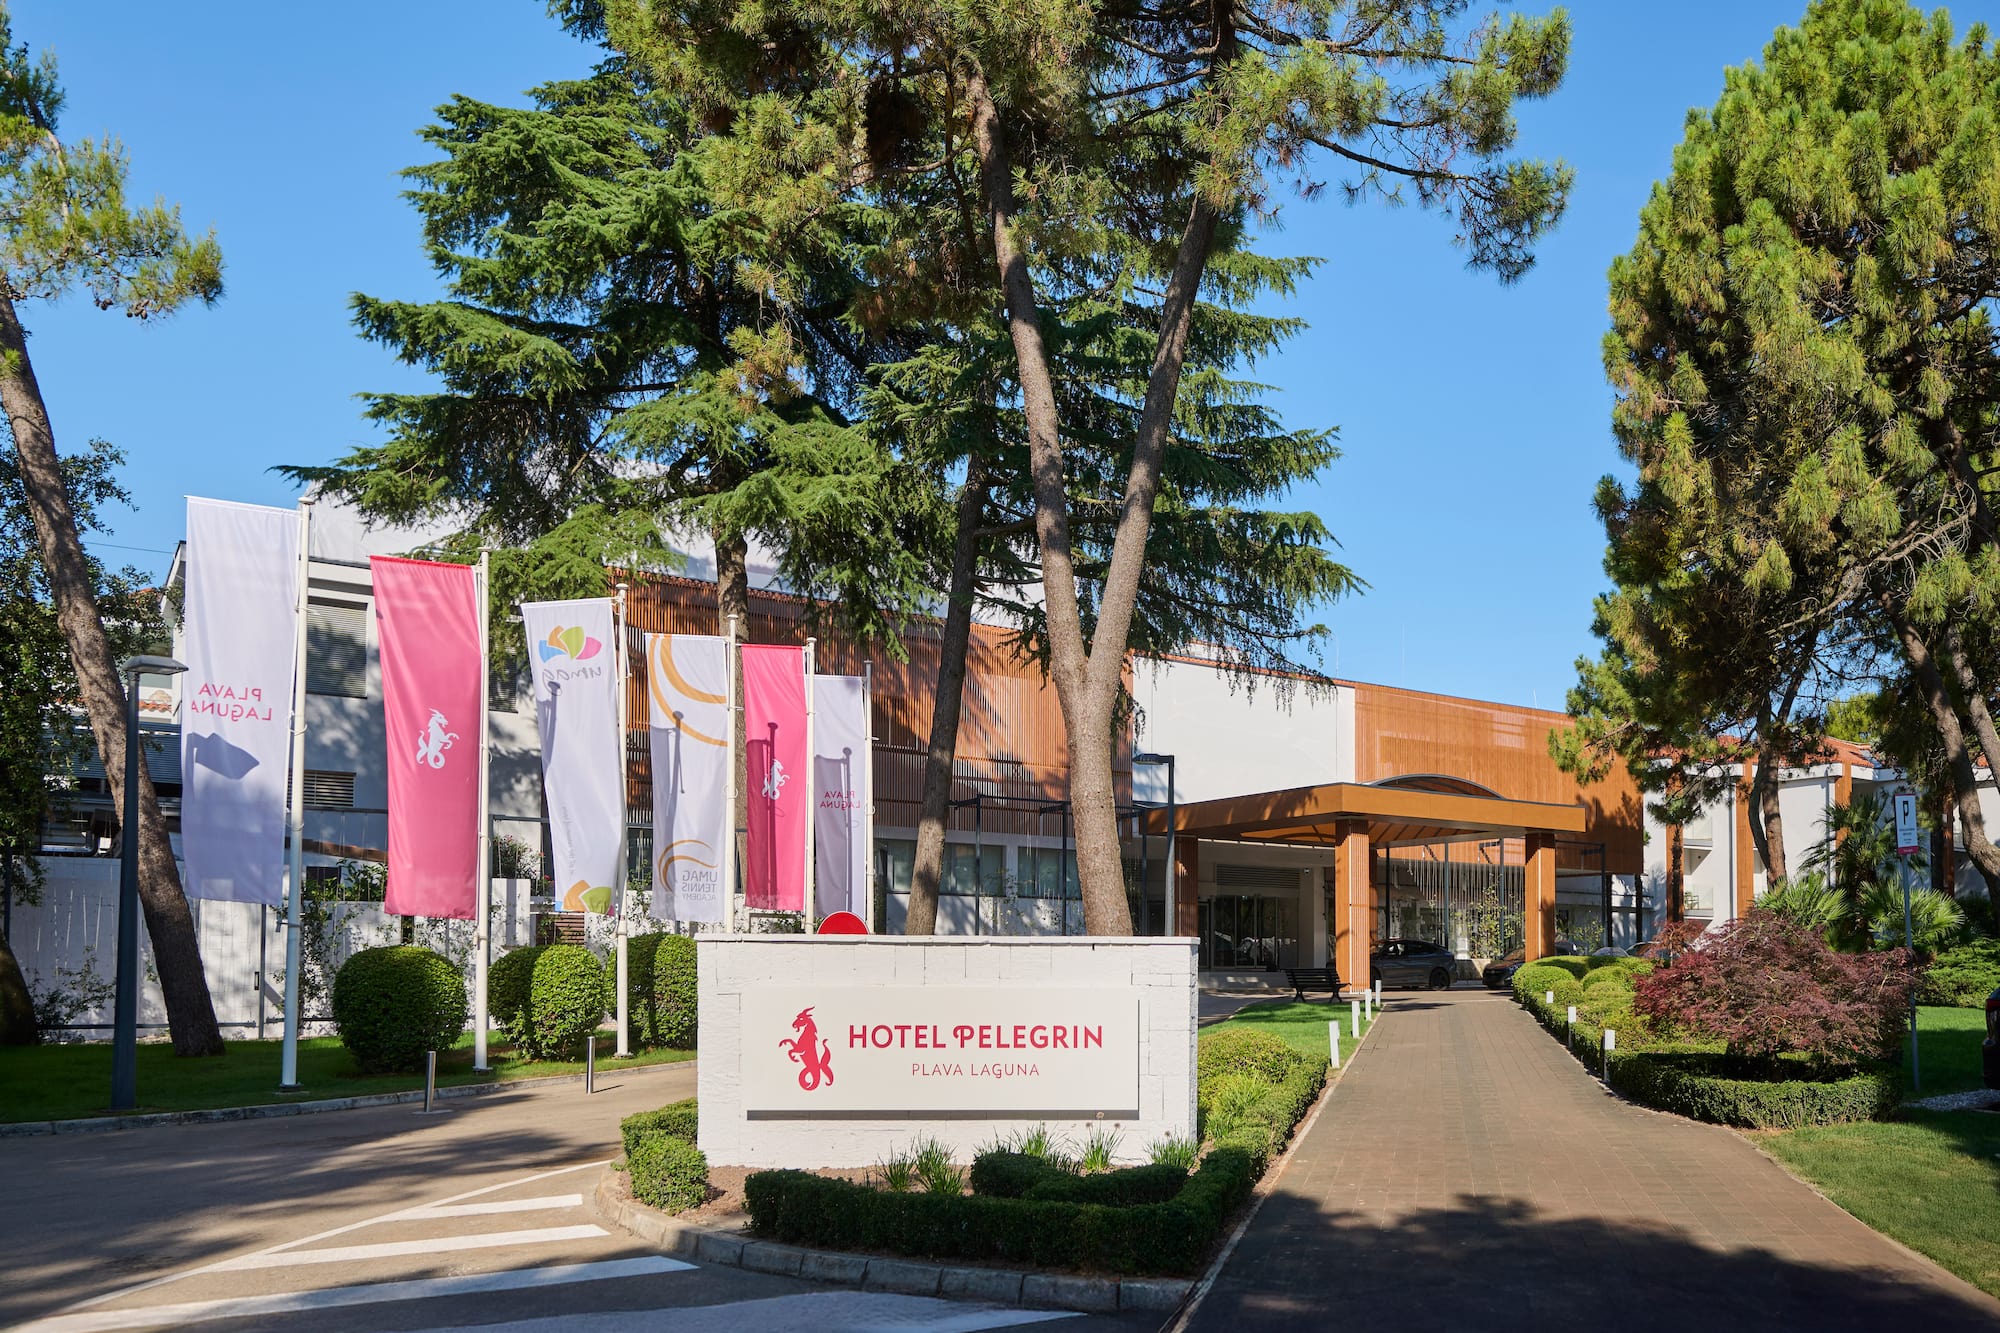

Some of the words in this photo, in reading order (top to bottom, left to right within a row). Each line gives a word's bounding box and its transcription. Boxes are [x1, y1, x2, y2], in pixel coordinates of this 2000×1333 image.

[848, 1024, 947, 1049] HOTEL
[952, 1024, 1103, 1049] PELEGRIN
[912, 1063, 964, 1077] PLAVA
[970, 1063, 1040, 1079] LAGUNA
